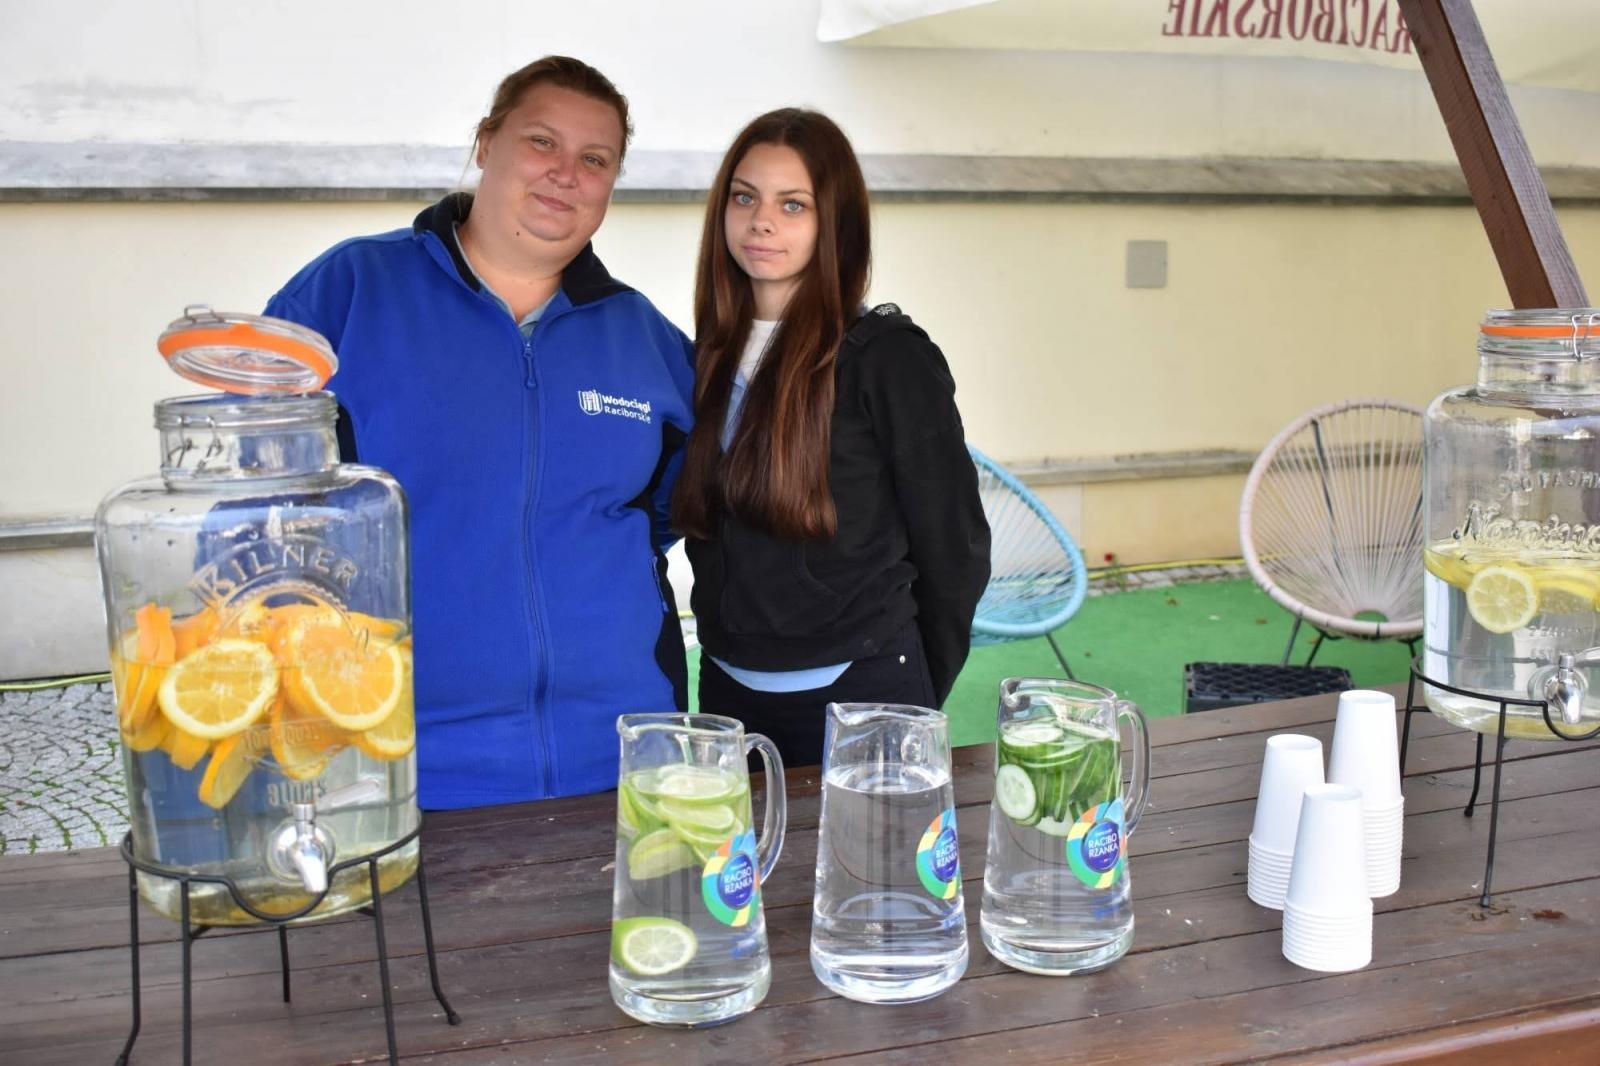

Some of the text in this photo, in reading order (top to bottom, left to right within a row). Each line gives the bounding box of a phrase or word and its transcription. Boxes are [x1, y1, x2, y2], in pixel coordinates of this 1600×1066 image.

[196, 544, 358, 604] KILNER
[1088, 833, 1117, 849] RACIBO
[723, 866, 752, 883] RACIBO
